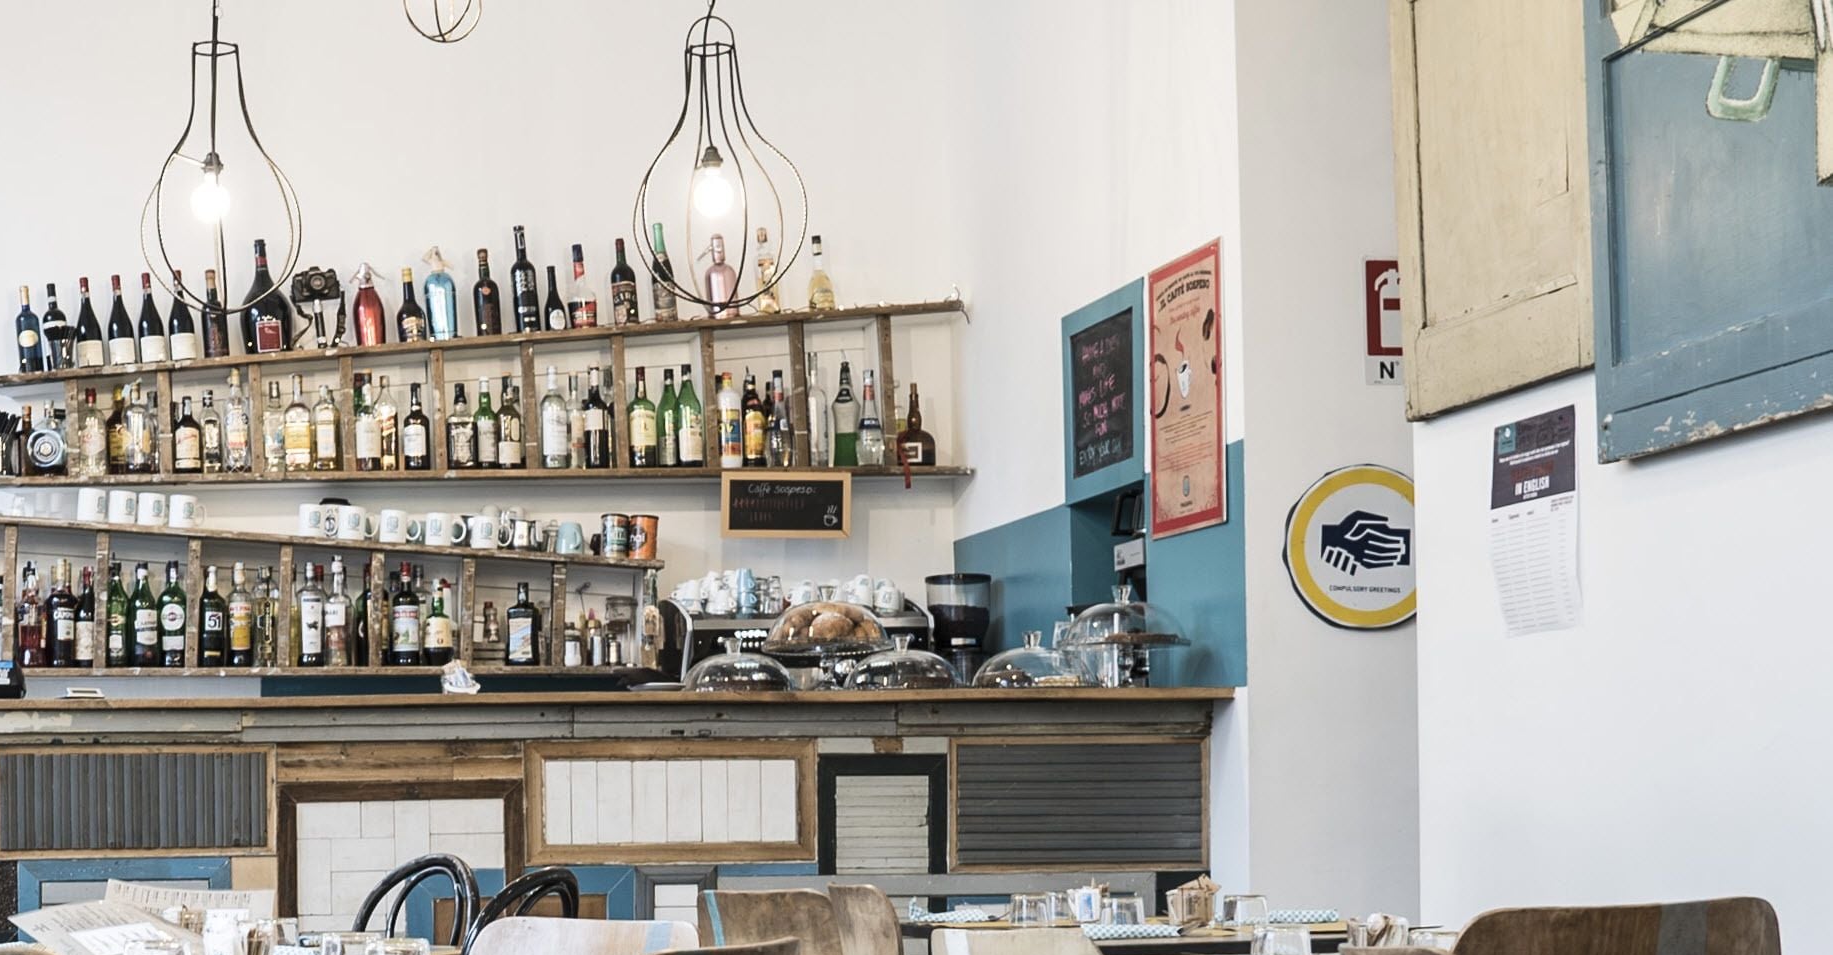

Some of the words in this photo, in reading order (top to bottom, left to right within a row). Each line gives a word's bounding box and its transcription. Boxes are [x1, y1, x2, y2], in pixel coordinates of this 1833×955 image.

[1523, 475, 1550, 494] ENGLISH
[1329, 584, 1368, 593] COMPULSORY
[1368, 586, 1401, 594] GREETINGS
[207, 613, 222, 629] 51
